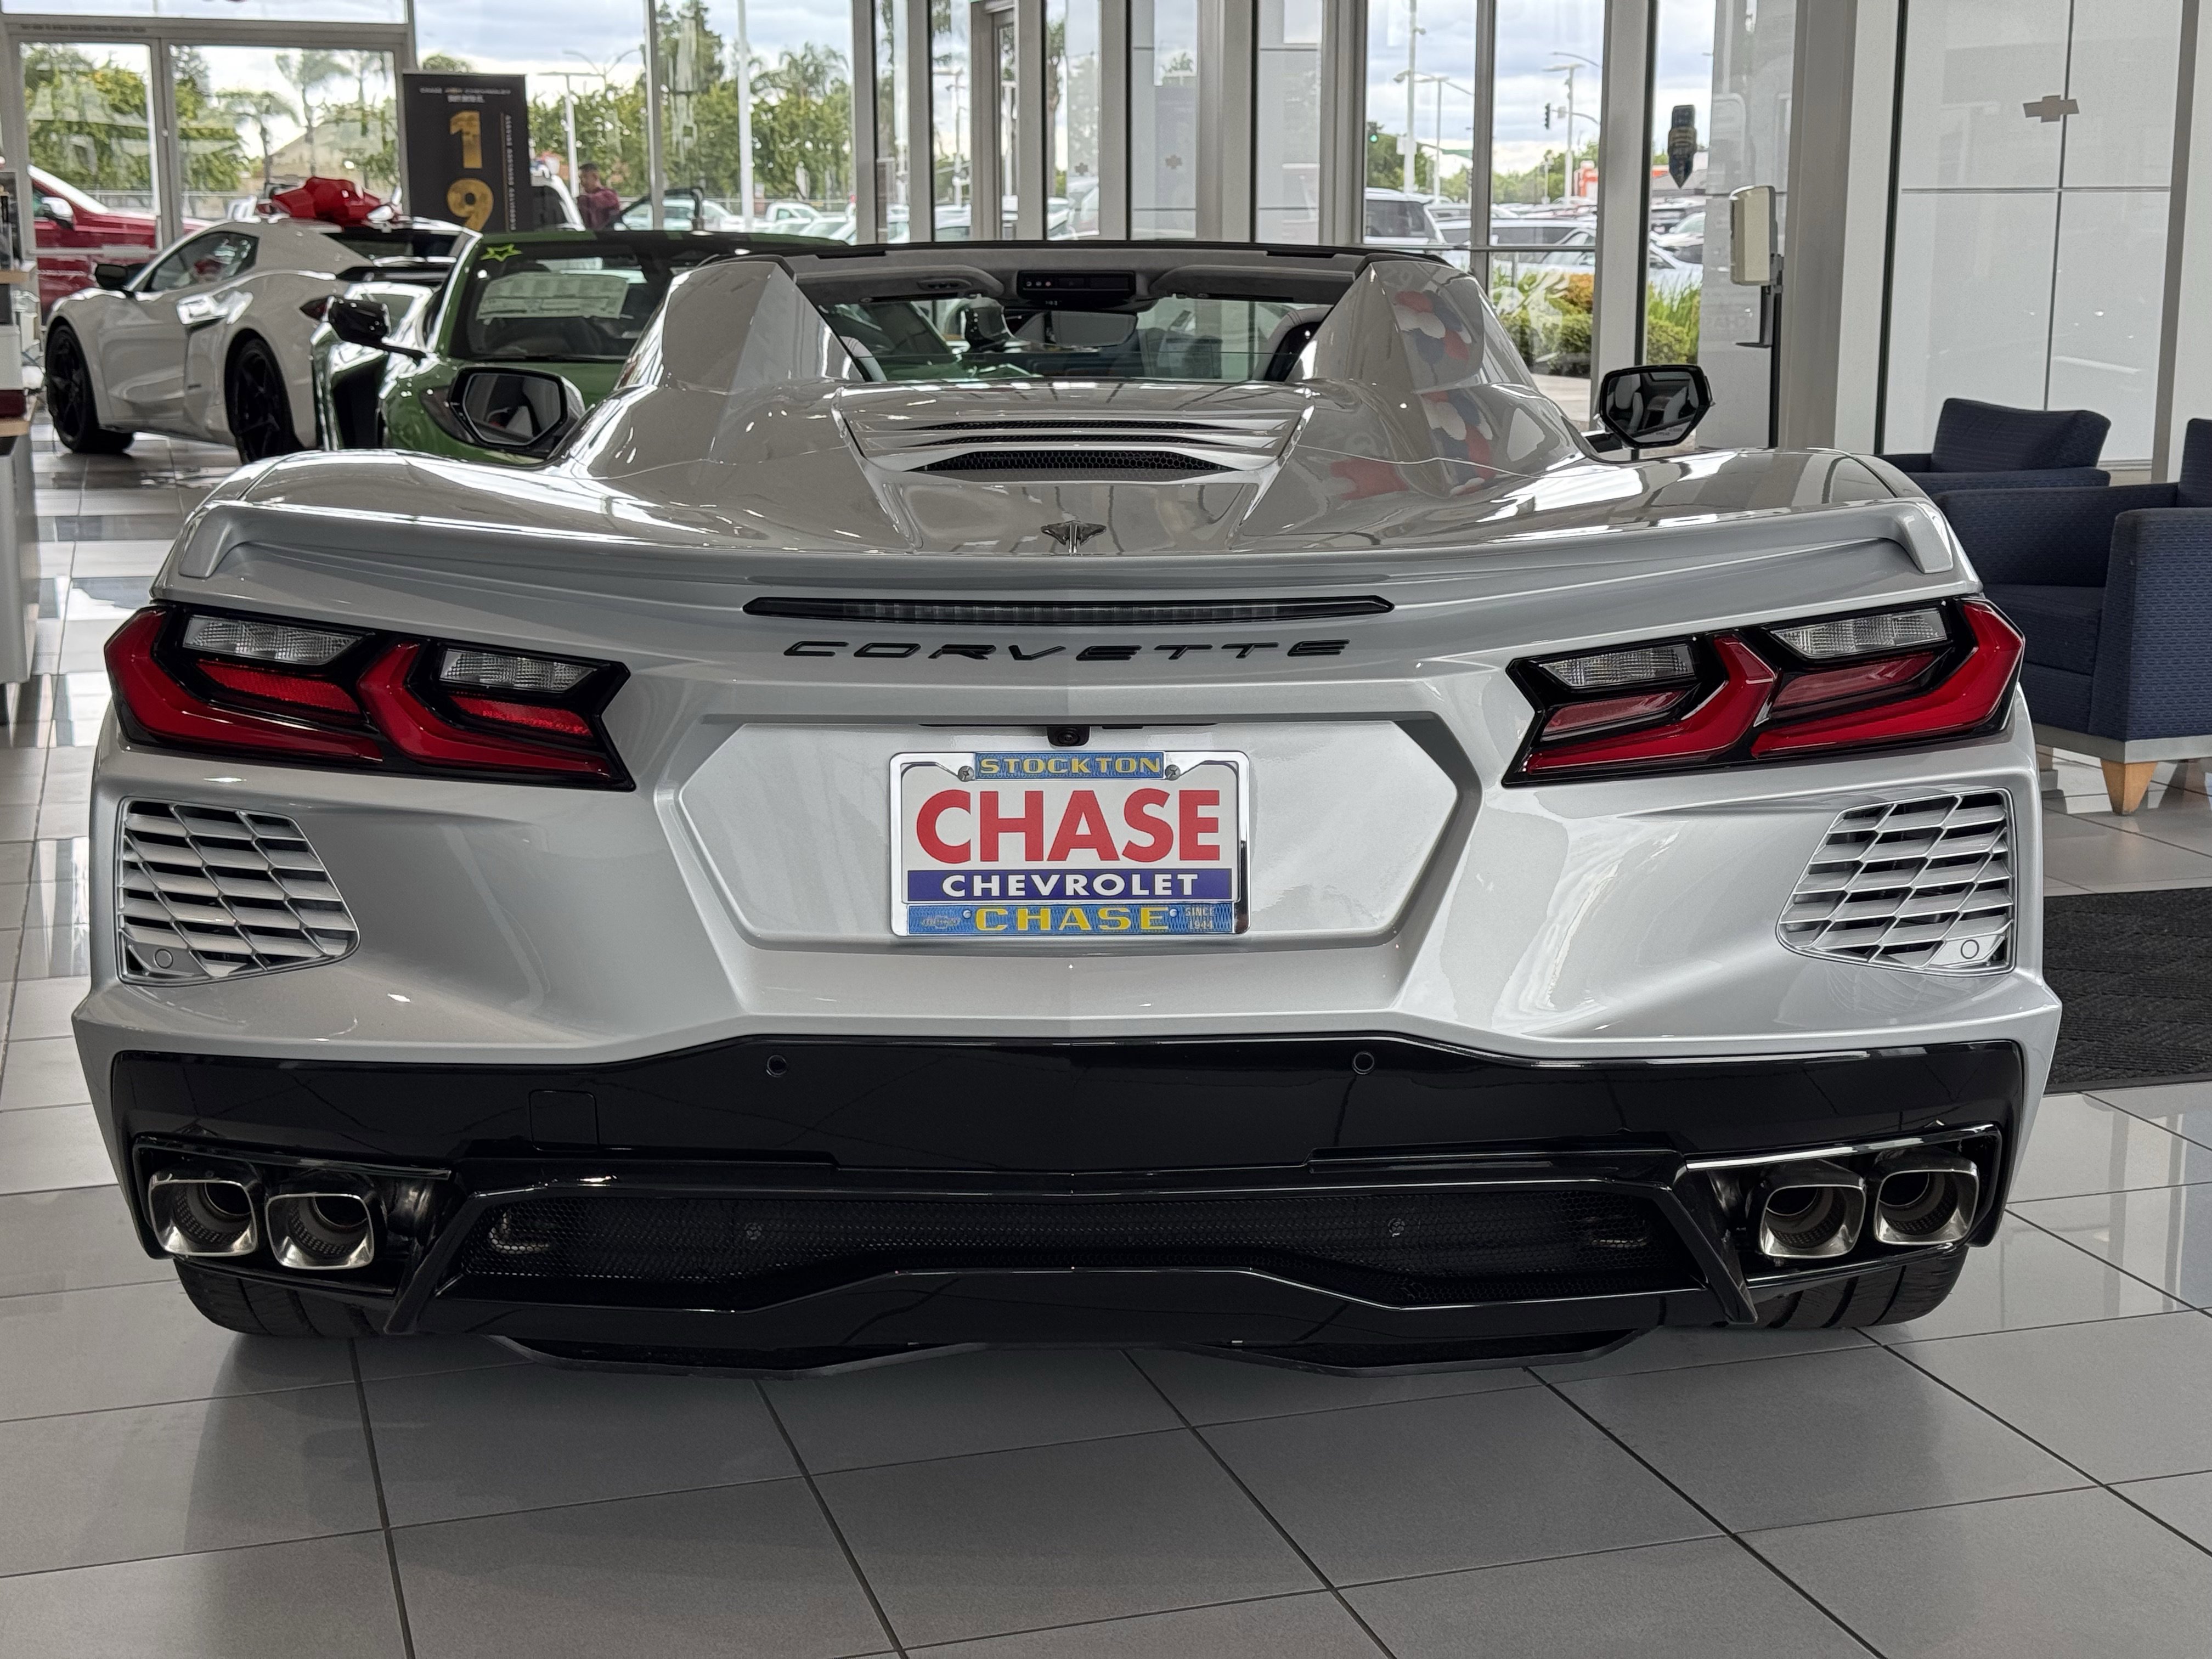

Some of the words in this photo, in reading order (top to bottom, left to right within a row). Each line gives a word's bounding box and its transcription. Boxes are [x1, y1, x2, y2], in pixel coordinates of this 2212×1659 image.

[449, 109, 483, 170] 1
[446, 177, 494, 232] 9
[783, 639, 1351, 662] CORVETTE
[980, 757, 1161, 774] STOCKTON
[916, 788, 1220, 864] CHASE
[942, 873, 1198, 898] CHEVROLET
[975, 905, 1169, 931] CHASE
[1185, 906, 1216, 917] SINCE
[1189, 919, 1213, 930] 1944
